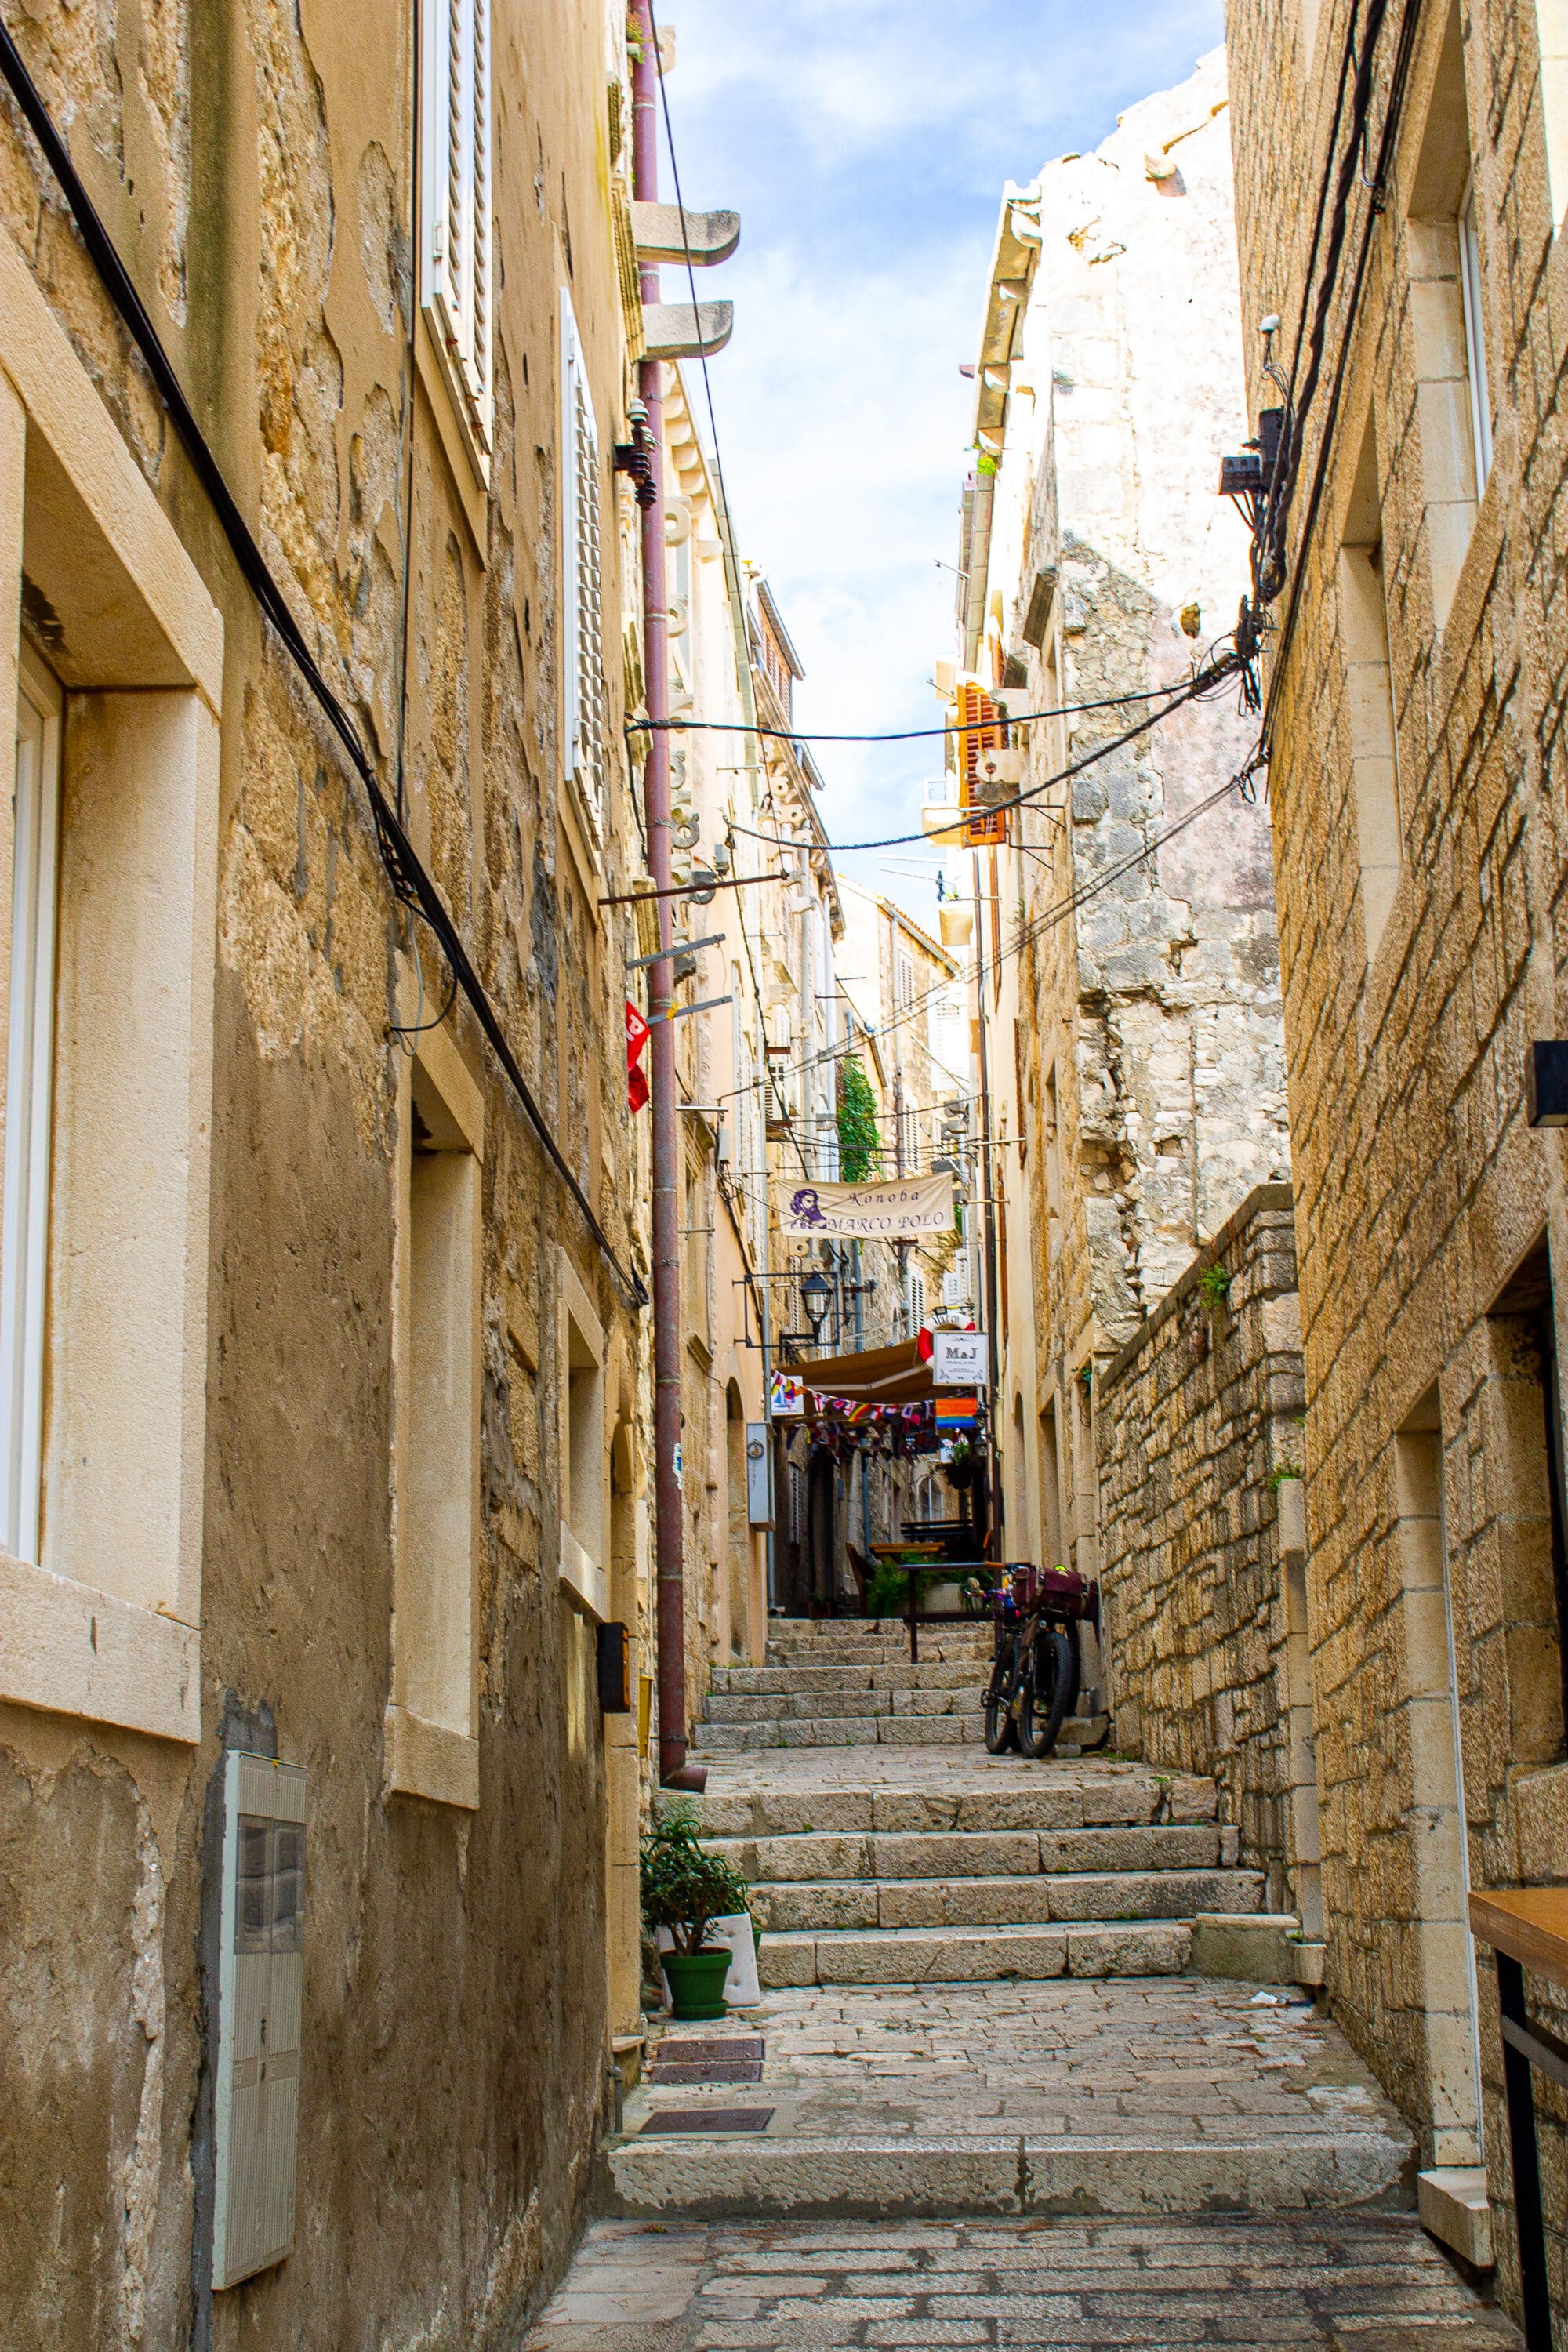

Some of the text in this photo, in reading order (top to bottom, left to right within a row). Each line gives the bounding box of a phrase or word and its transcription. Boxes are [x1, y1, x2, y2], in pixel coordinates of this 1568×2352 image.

[848, 1188, 920, 1207] Konoba
[827, 1212, 944, 1232] MARCO POLO
